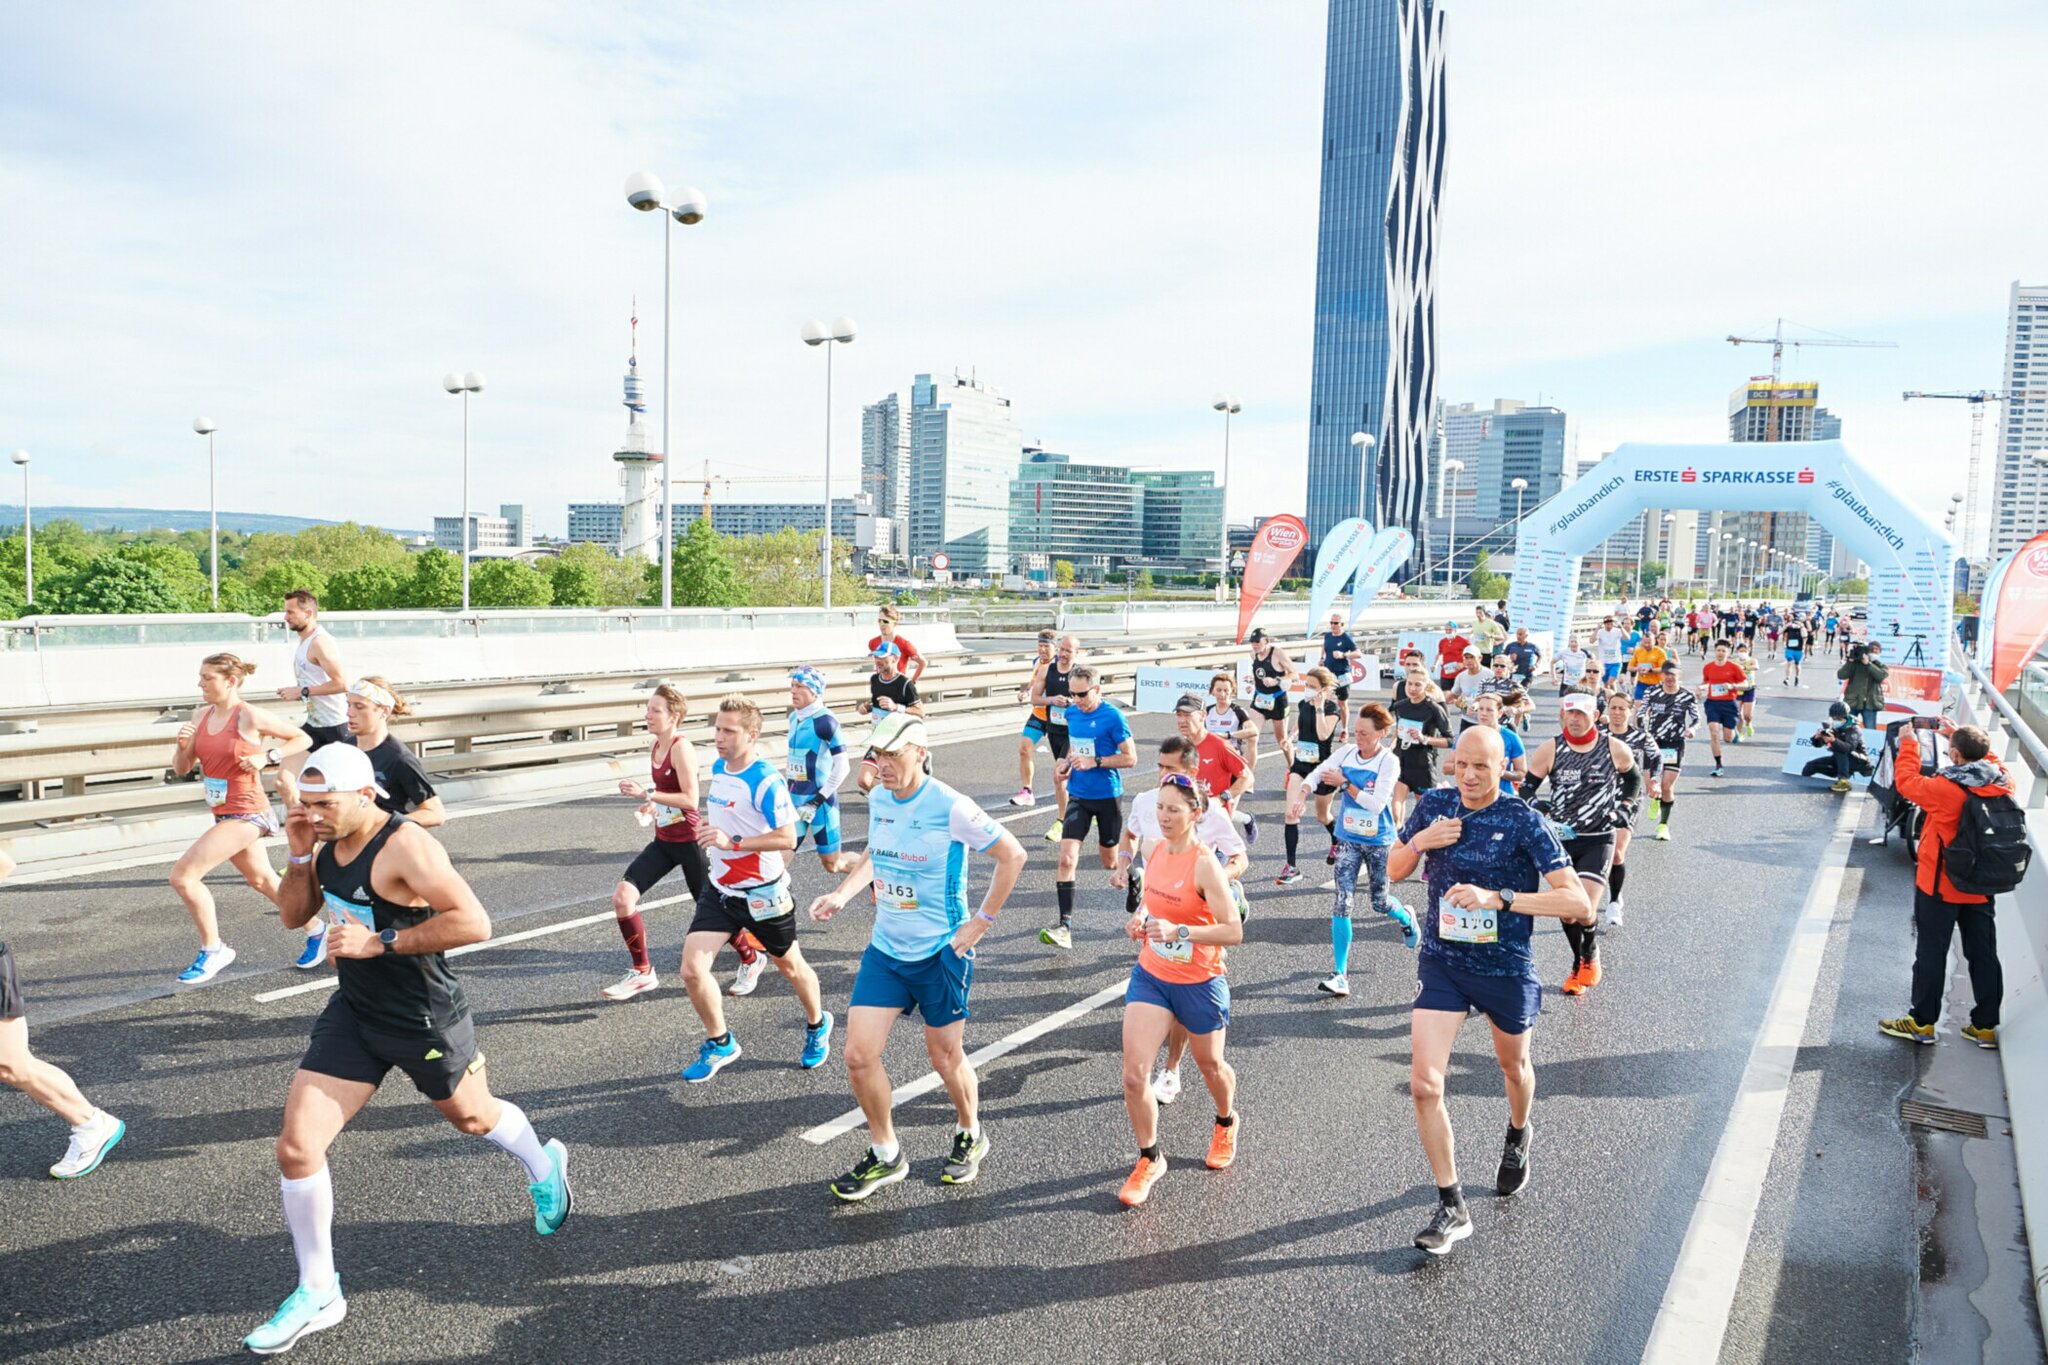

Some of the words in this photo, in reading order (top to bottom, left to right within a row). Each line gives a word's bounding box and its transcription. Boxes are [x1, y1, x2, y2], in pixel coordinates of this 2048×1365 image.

[1635, 470, 1678, 482] ERSTE
[1702, 471, 1795, 484] SPARKASSE
[1549, 474, 1625, 536] #glaubandich
[1825, 479, 1904, 550] #glaubandich
[1270, 527, 1296, 538] Wien
[1176, 682, 1210, 690] SPARKAS
[1079, 747, 1090, 755] 43
[1359, 819, 1373, 828] 28
[887, 883, 914, 898] 163
